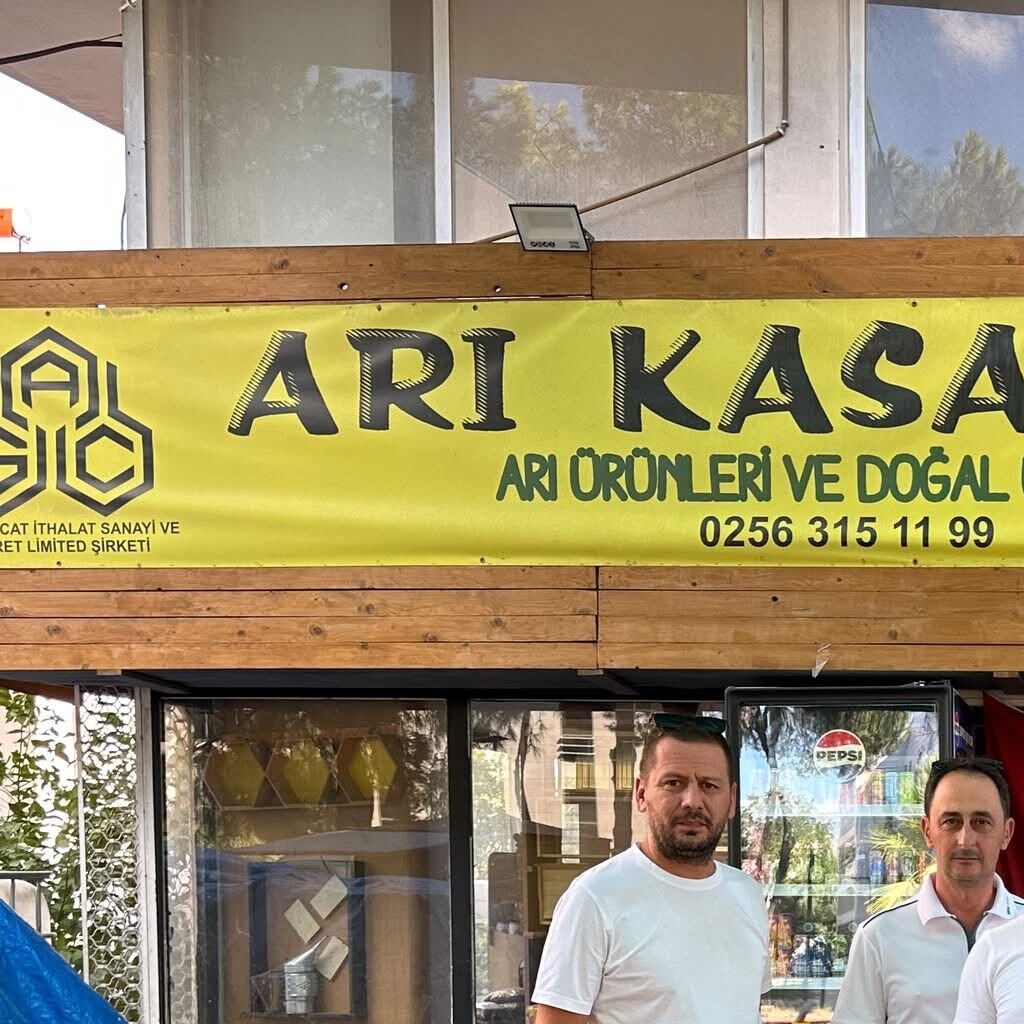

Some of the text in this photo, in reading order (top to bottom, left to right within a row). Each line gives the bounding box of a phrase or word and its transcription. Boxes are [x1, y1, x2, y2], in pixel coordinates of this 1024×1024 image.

[228, 328, 516, 436] ARI
[496, 453, 558, 502] ARI
[570, 446, 772, 503] ÜRÜNLERİ
[781, 453, 845, 502] VE
[856, 446, 1010, 503] DOĞAL
[34, 520, 96, 535] İTHALAT
[100, 519, 156, 535] SANAYİ
[160, 521, 180, 534] VE
[699, 515, 995, 549] 0256 315 11 99
[27, 538, 87, 553] LİMİTED
[91, 537, 151, 556] ŞİRKETİ
[816, 750, 863, 762] PEPSI
